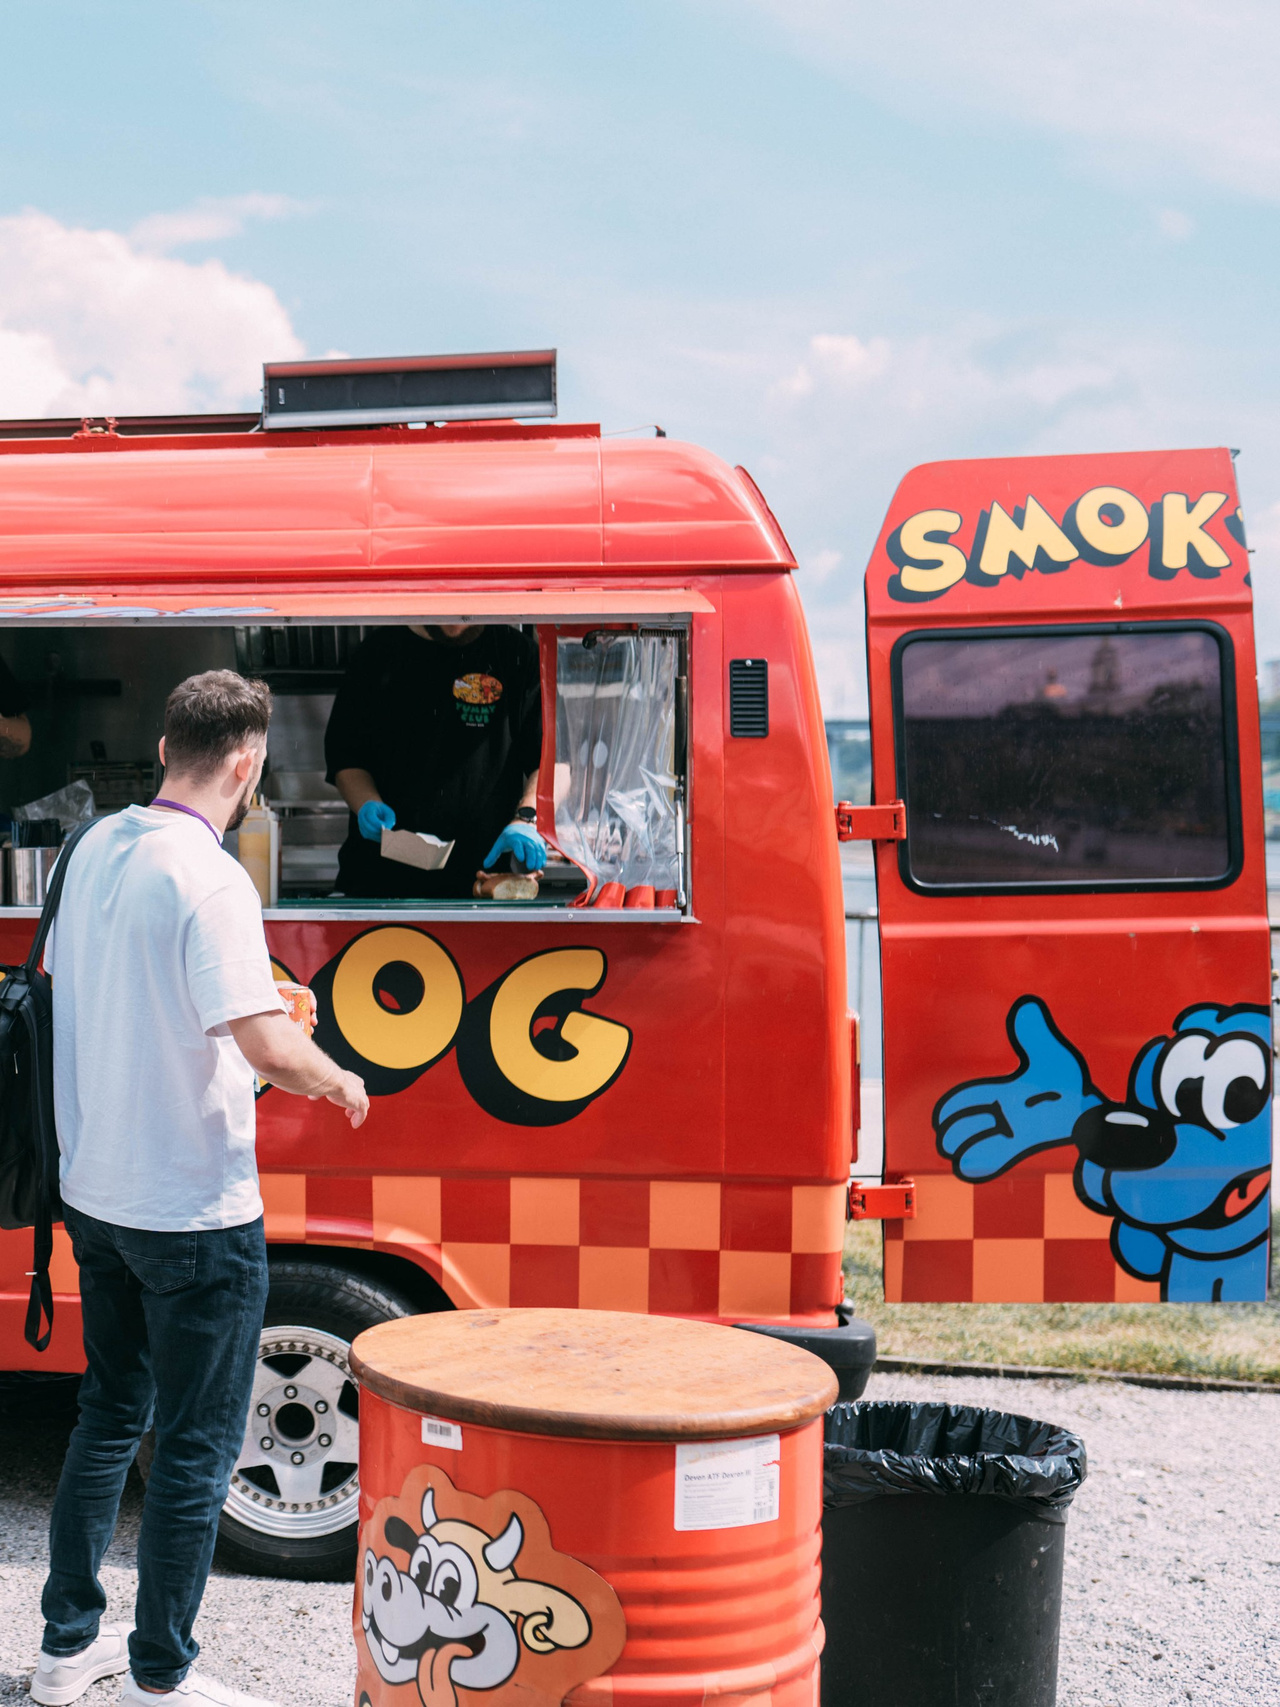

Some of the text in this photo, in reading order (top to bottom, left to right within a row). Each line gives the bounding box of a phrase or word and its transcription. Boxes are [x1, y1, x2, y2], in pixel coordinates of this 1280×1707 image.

[886, 486, 1252, 603] SMOK
[456, 702, 496, 713] YUMMY
[461, 713, 490, 723] CLUB
[257, 924, 632, 1127] OG
